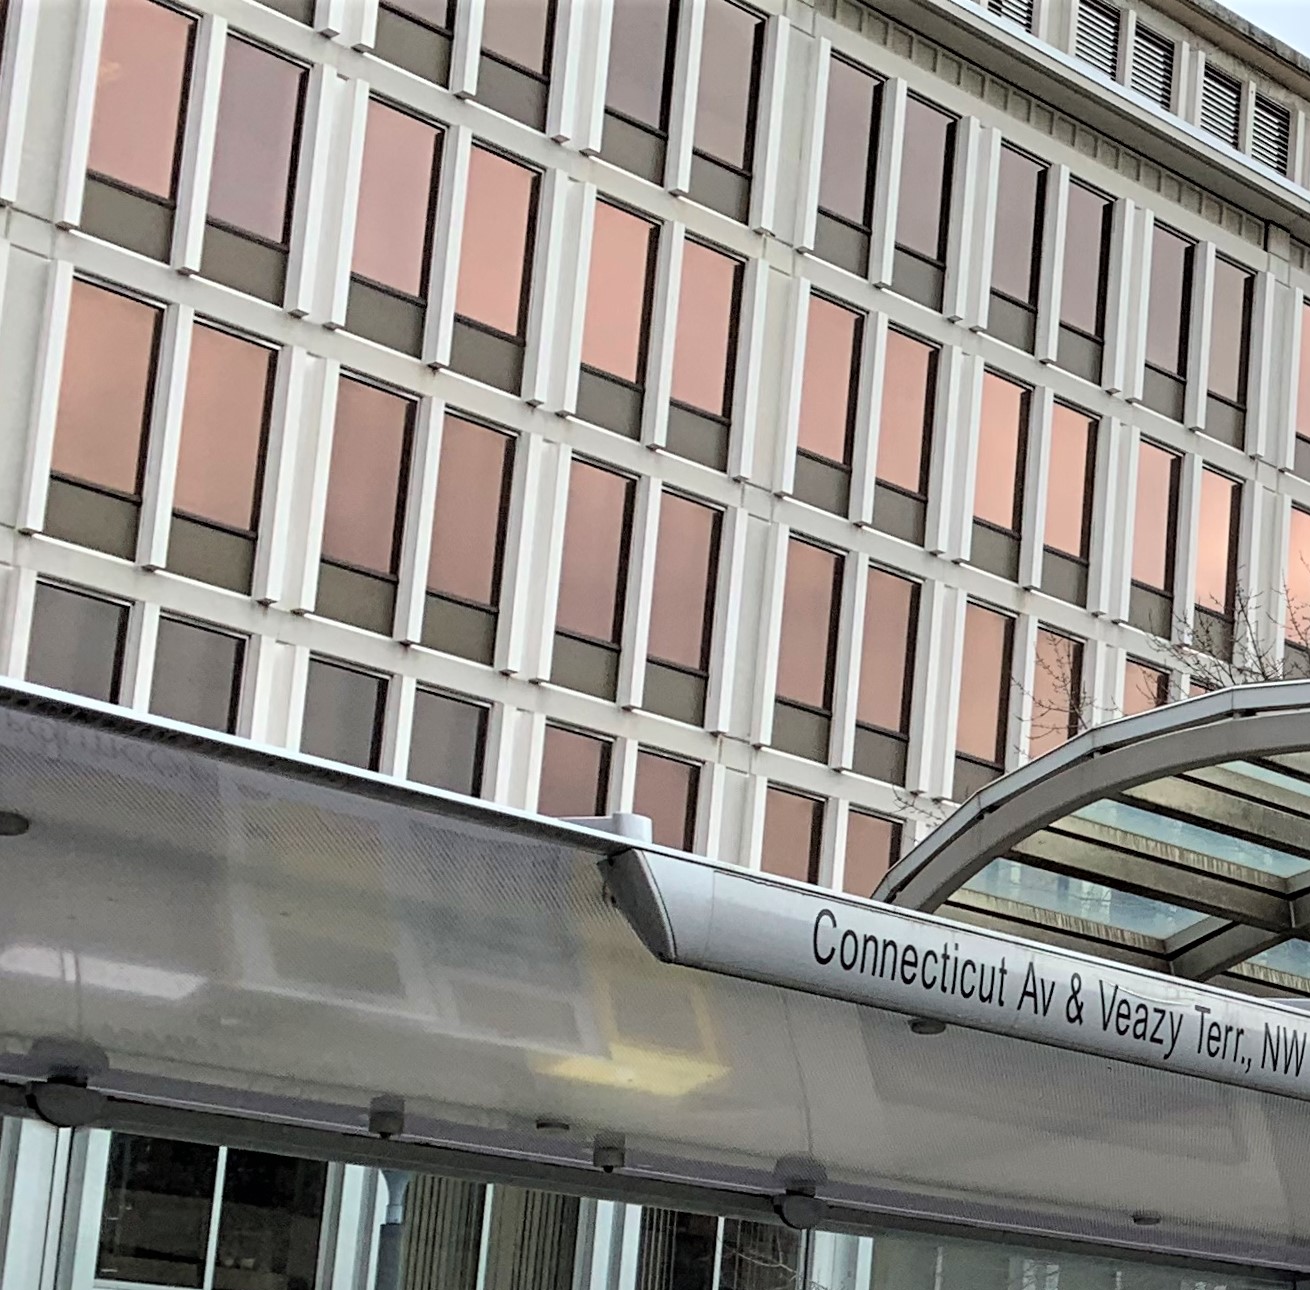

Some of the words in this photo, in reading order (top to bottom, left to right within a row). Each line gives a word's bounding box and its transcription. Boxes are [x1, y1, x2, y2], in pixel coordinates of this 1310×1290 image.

[812, 908, 1008, 1007] Connecticut
[1017, 961, 1057, 1017] Av
[1065, 973, 1085, 1025] &
[1098, 979, 1184, 1060] Veazy
[1194, 1004, 1254, 1076] Terr.,
[1261, 1026, 1307, 1079] NW
